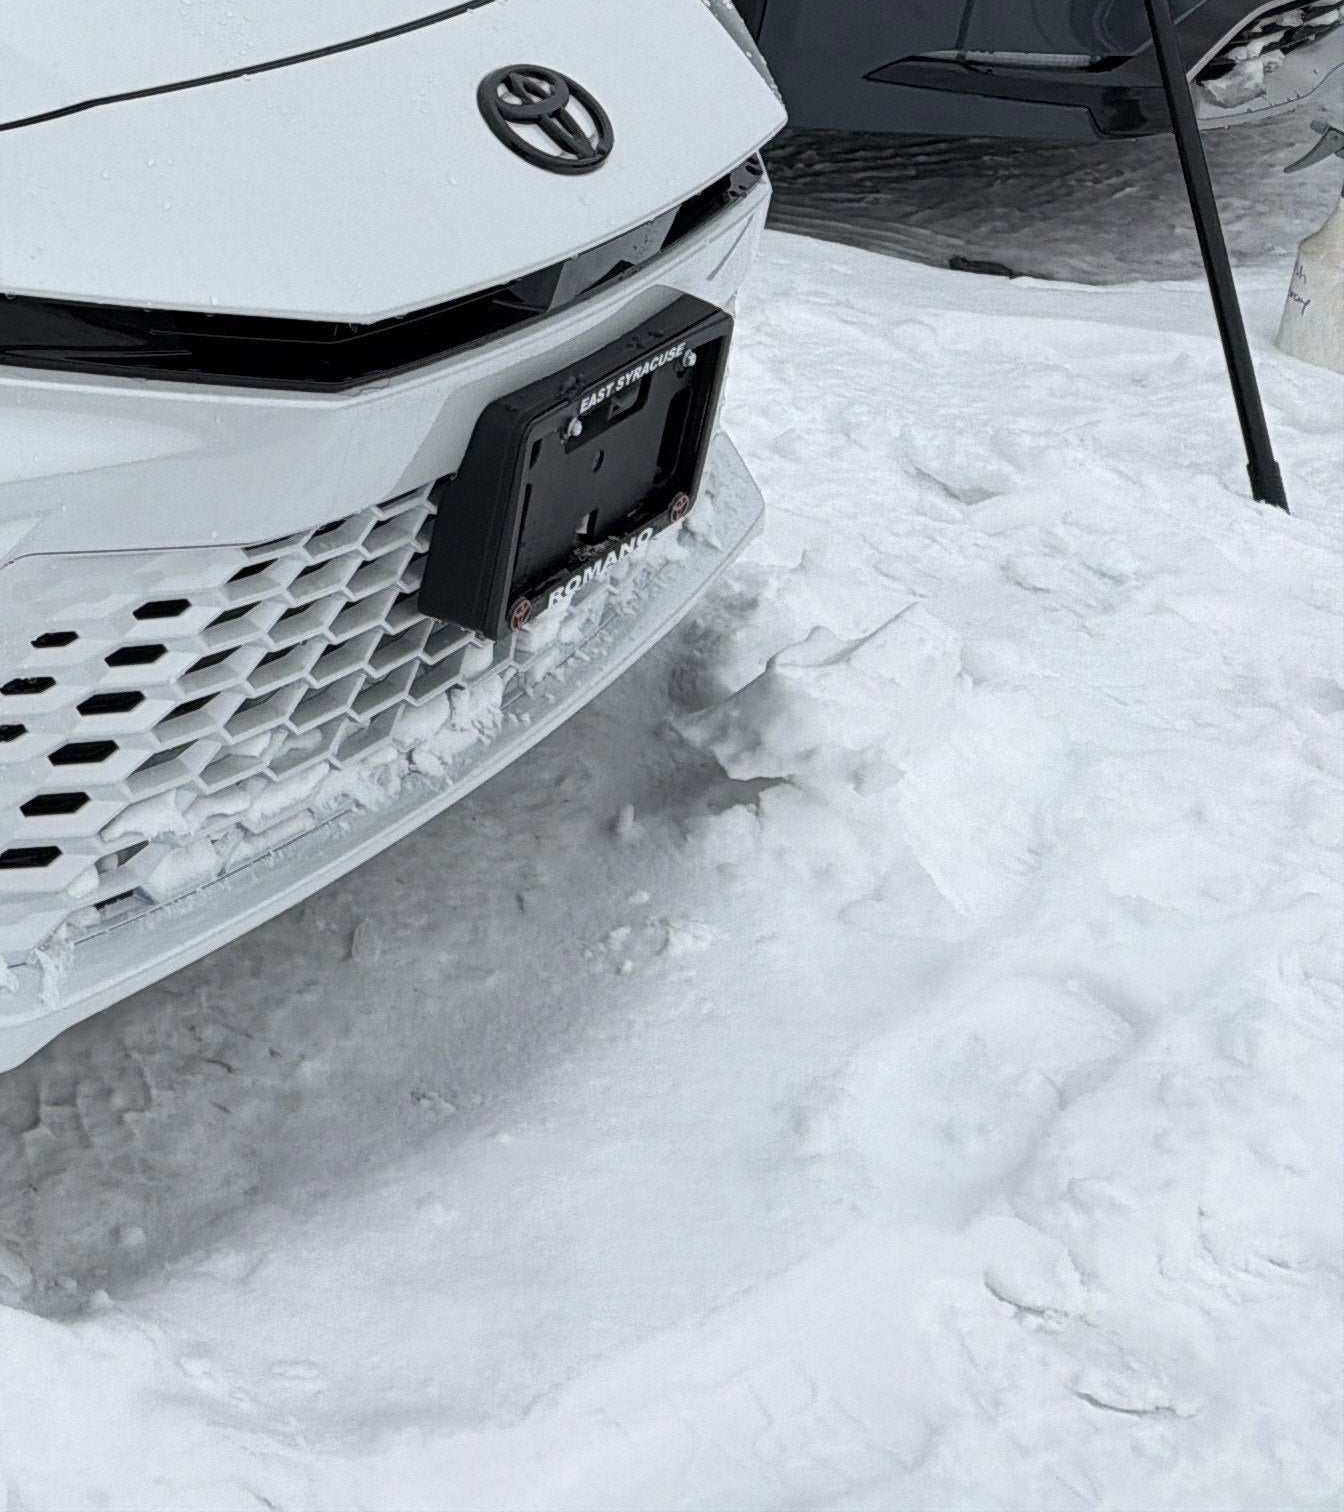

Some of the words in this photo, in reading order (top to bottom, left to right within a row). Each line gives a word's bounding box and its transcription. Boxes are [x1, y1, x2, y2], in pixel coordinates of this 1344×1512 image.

[579, 380, 615, 415] EAST
[615, 341, 687, 392] SYRACUSE
[547, 527, 654, 610] ROMANO
